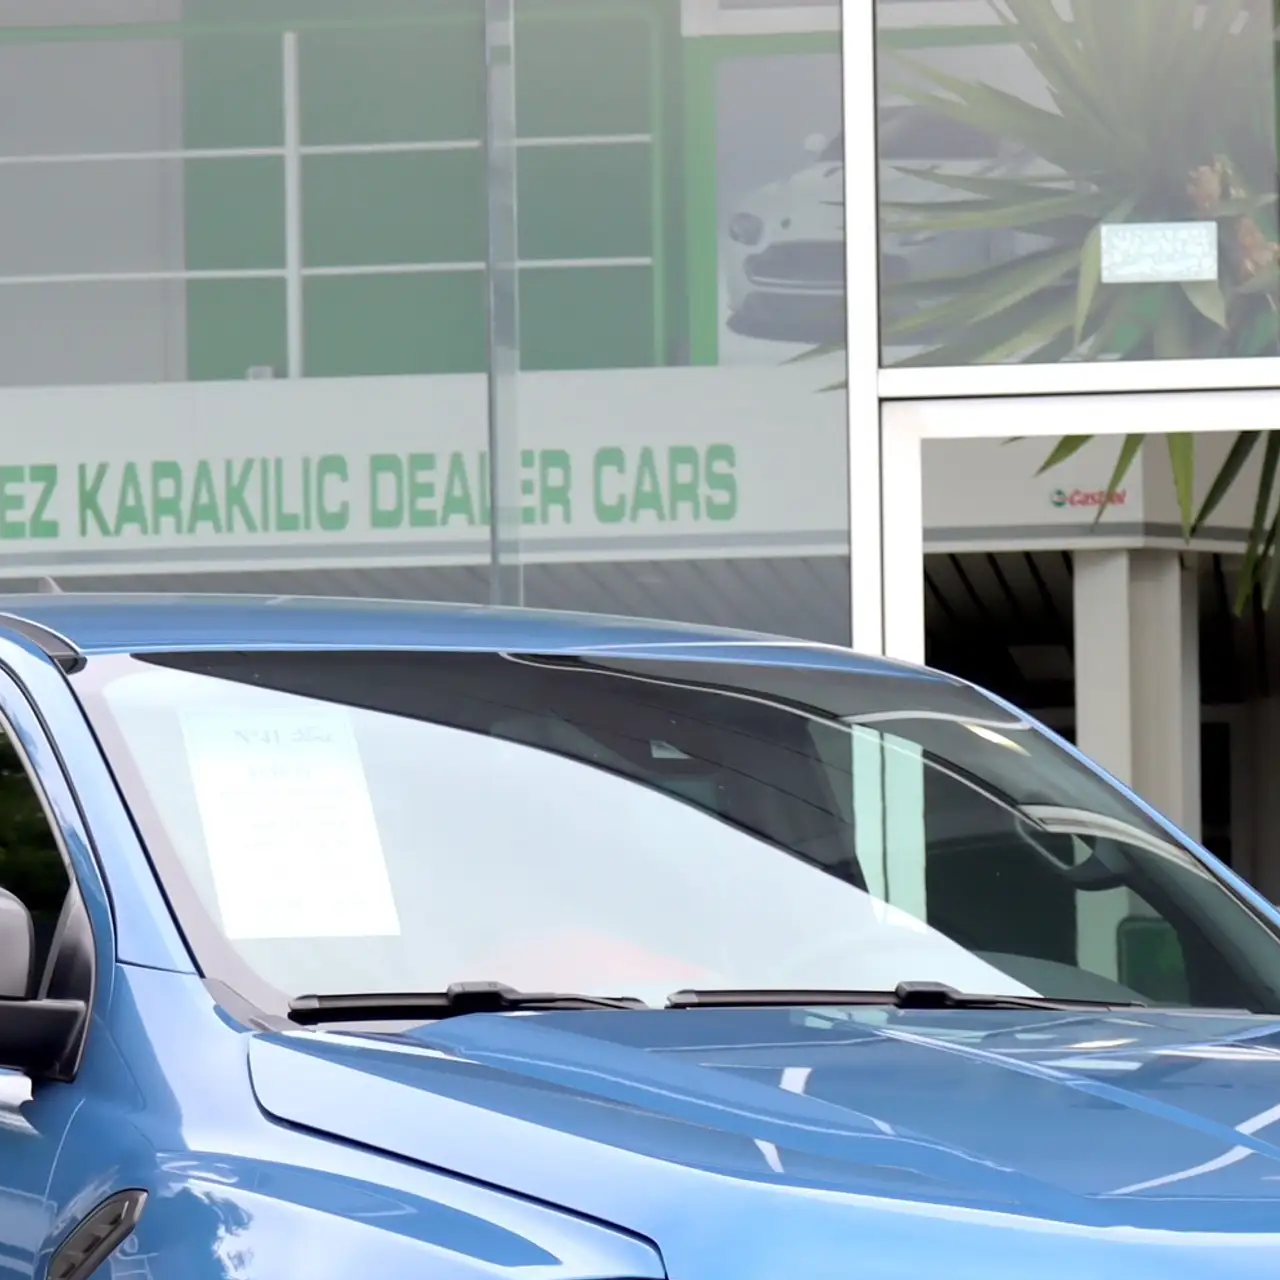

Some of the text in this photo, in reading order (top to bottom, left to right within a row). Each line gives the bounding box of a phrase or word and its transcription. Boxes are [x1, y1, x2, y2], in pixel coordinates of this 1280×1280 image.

[78, 454, 350, 538] KARAKILIC
[370, 448, 572, 530] DEALER
[593, 443, 739, 523] CARS
